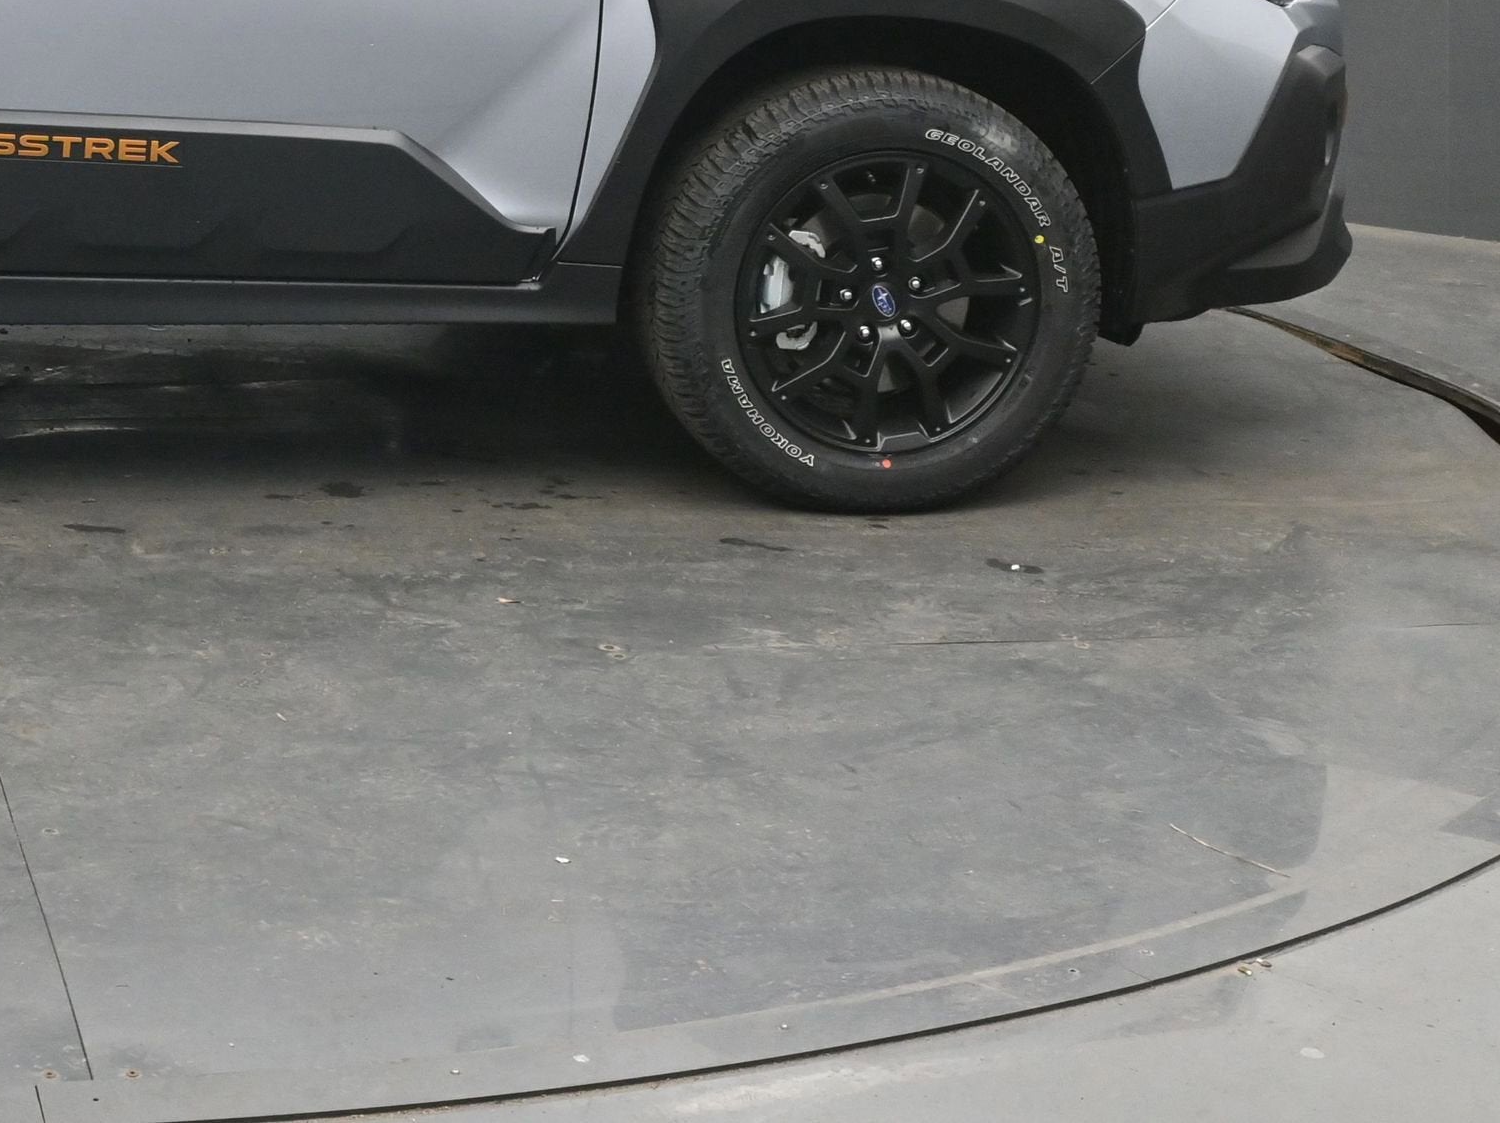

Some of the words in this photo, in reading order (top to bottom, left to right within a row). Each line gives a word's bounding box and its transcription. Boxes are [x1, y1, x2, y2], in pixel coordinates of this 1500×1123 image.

[925, 128, 1051, 228] GEOLANDAR
[1049, 246, 1069, 293] A/T
[721, 357, 815, 467] YOKOHAMA
